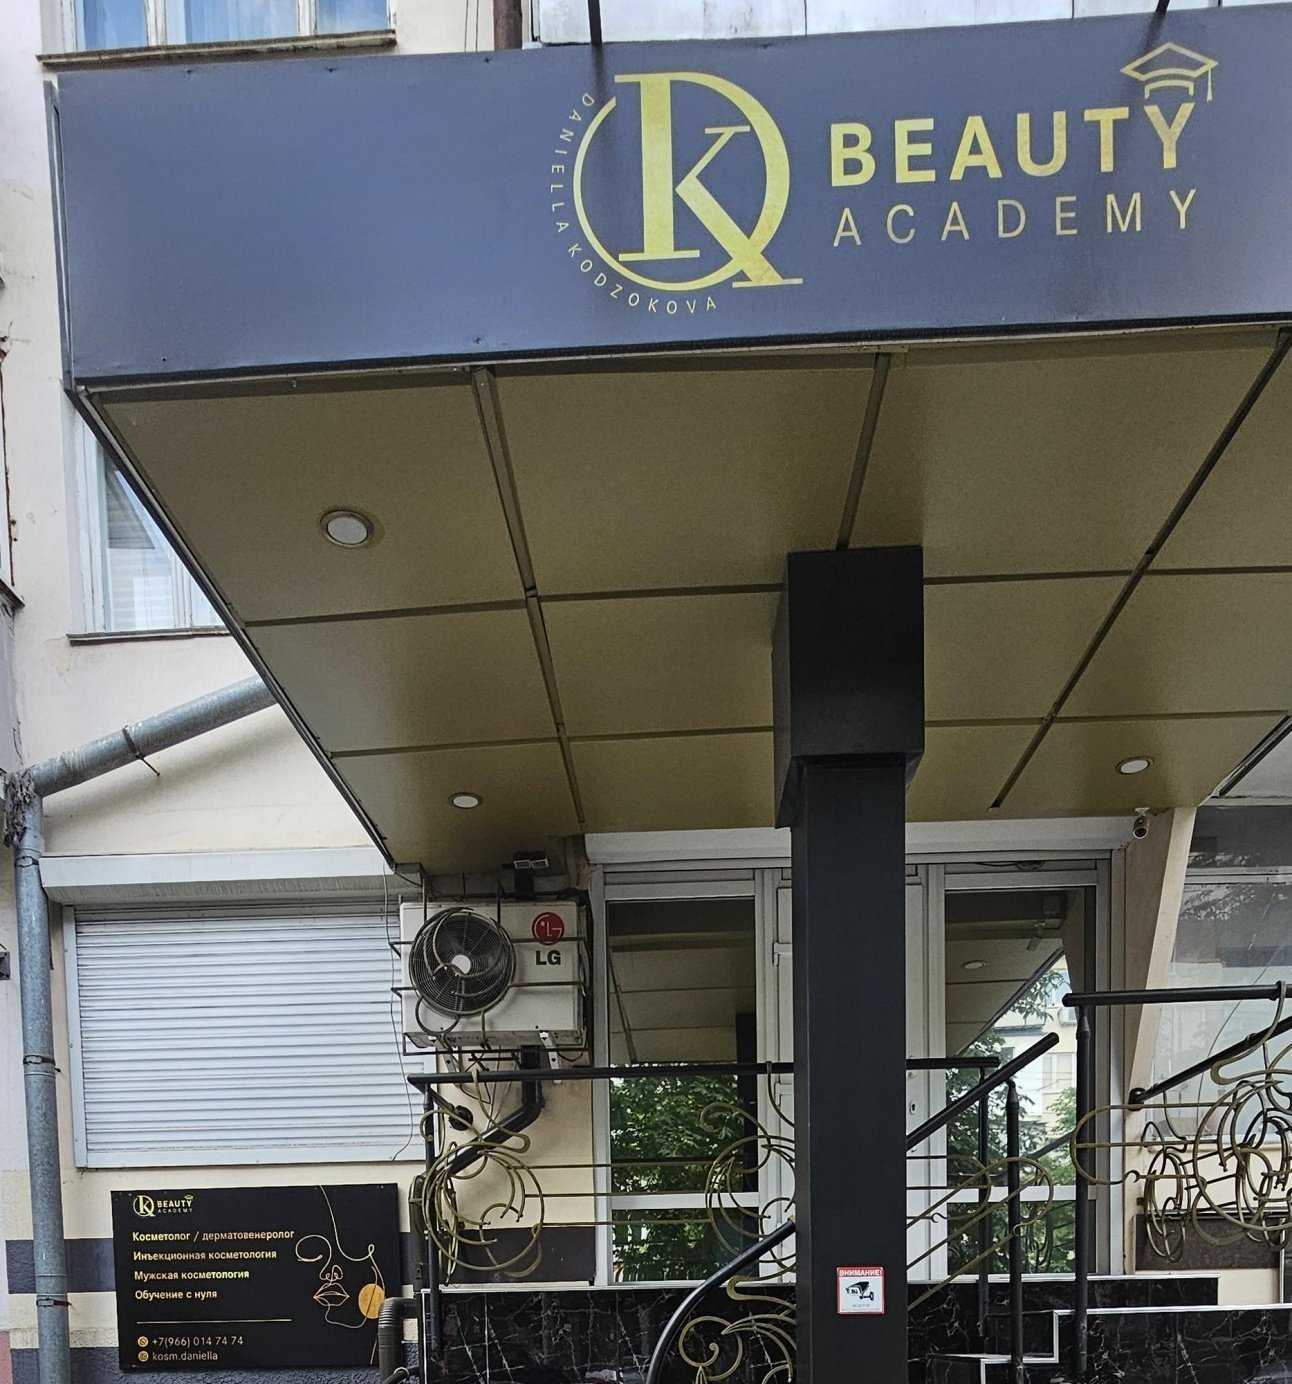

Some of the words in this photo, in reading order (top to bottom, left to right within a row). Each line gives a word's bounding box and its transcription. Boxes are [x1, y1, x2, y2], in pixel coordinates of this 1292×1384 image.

[830, 101, 1196, 187] BEAUTY
[550, 92, 595, 233] DANIELLA
[833, 189, 1198, 248] ACADEMY
[568, 243, 717, 315] KODZOKOVA
[535, 950, 562, 966] LG
[157, 1200, 192, 1208] BEAUTY
[132, 1231, 191, 1242] Косметолог
[201, 1230, 295, 1242] дерматовенеролог
[133, 1251, 206, 1262] Инъекционная
[208, 1250, 277, 1260] косметология
[134, 1271, 179, 1281] Мужская
[181, 1269, 249, 1279] косметология
[135, 1290, 184, 1300] Обучение
[194, 1290, 218, 1299] нуля
[152, 1337, 191, 1348] +7(966)
[193, 1336, 212, 1346] 014
[215, 1336, 228, 1345] 74
[231, 1335, 244, 1345] 74
[152, 1351, 218, 1360] kosm.daniella
